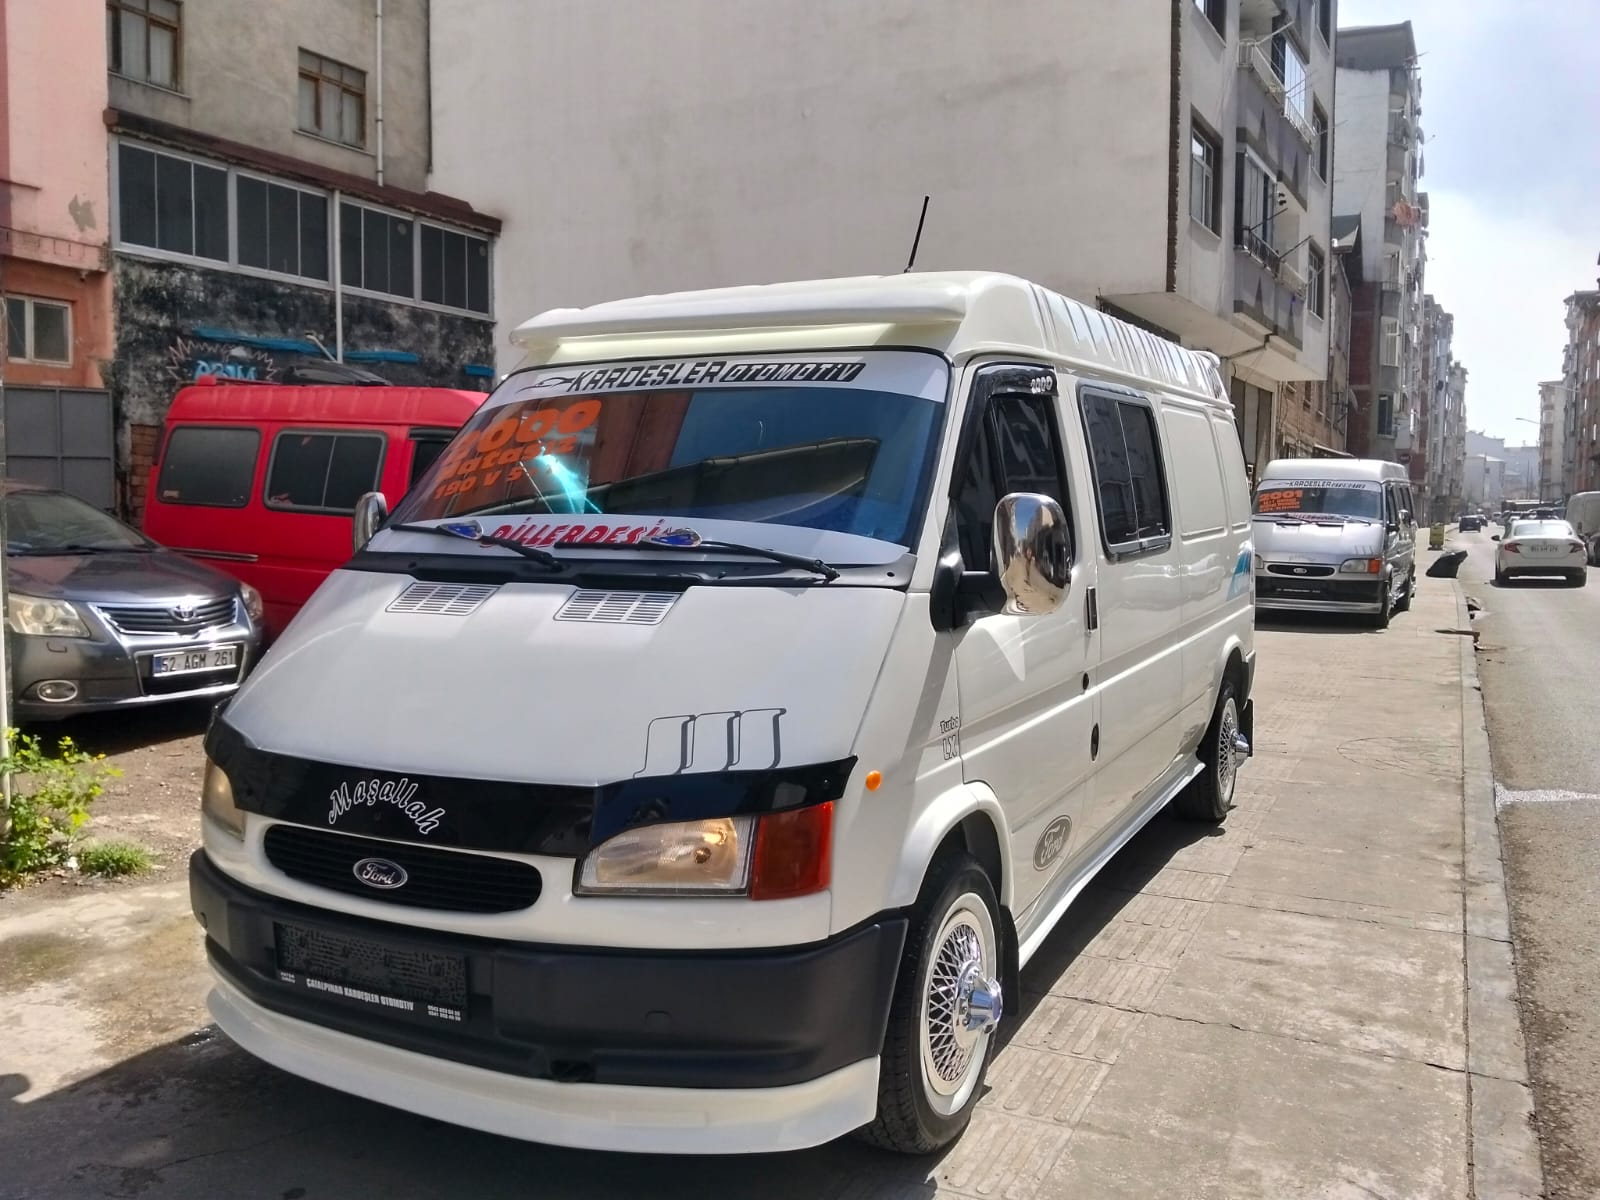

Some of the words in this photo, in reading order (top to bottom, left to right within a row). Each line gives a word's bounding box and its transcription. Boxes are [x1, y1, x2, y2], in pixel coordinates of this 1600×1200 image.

[434, 476, 477, 499] 190
[1259, 490, 1303, 501] 2001
[161, 657, 176, 673] 52
[184, 653, 207, 669] AGM
[215, 651, 233, 667] 261
[328, 778, 446, 834] Maşallah
[1040, 823, 1066, 865] Ford
[362, 862, 395, 885] Ford
